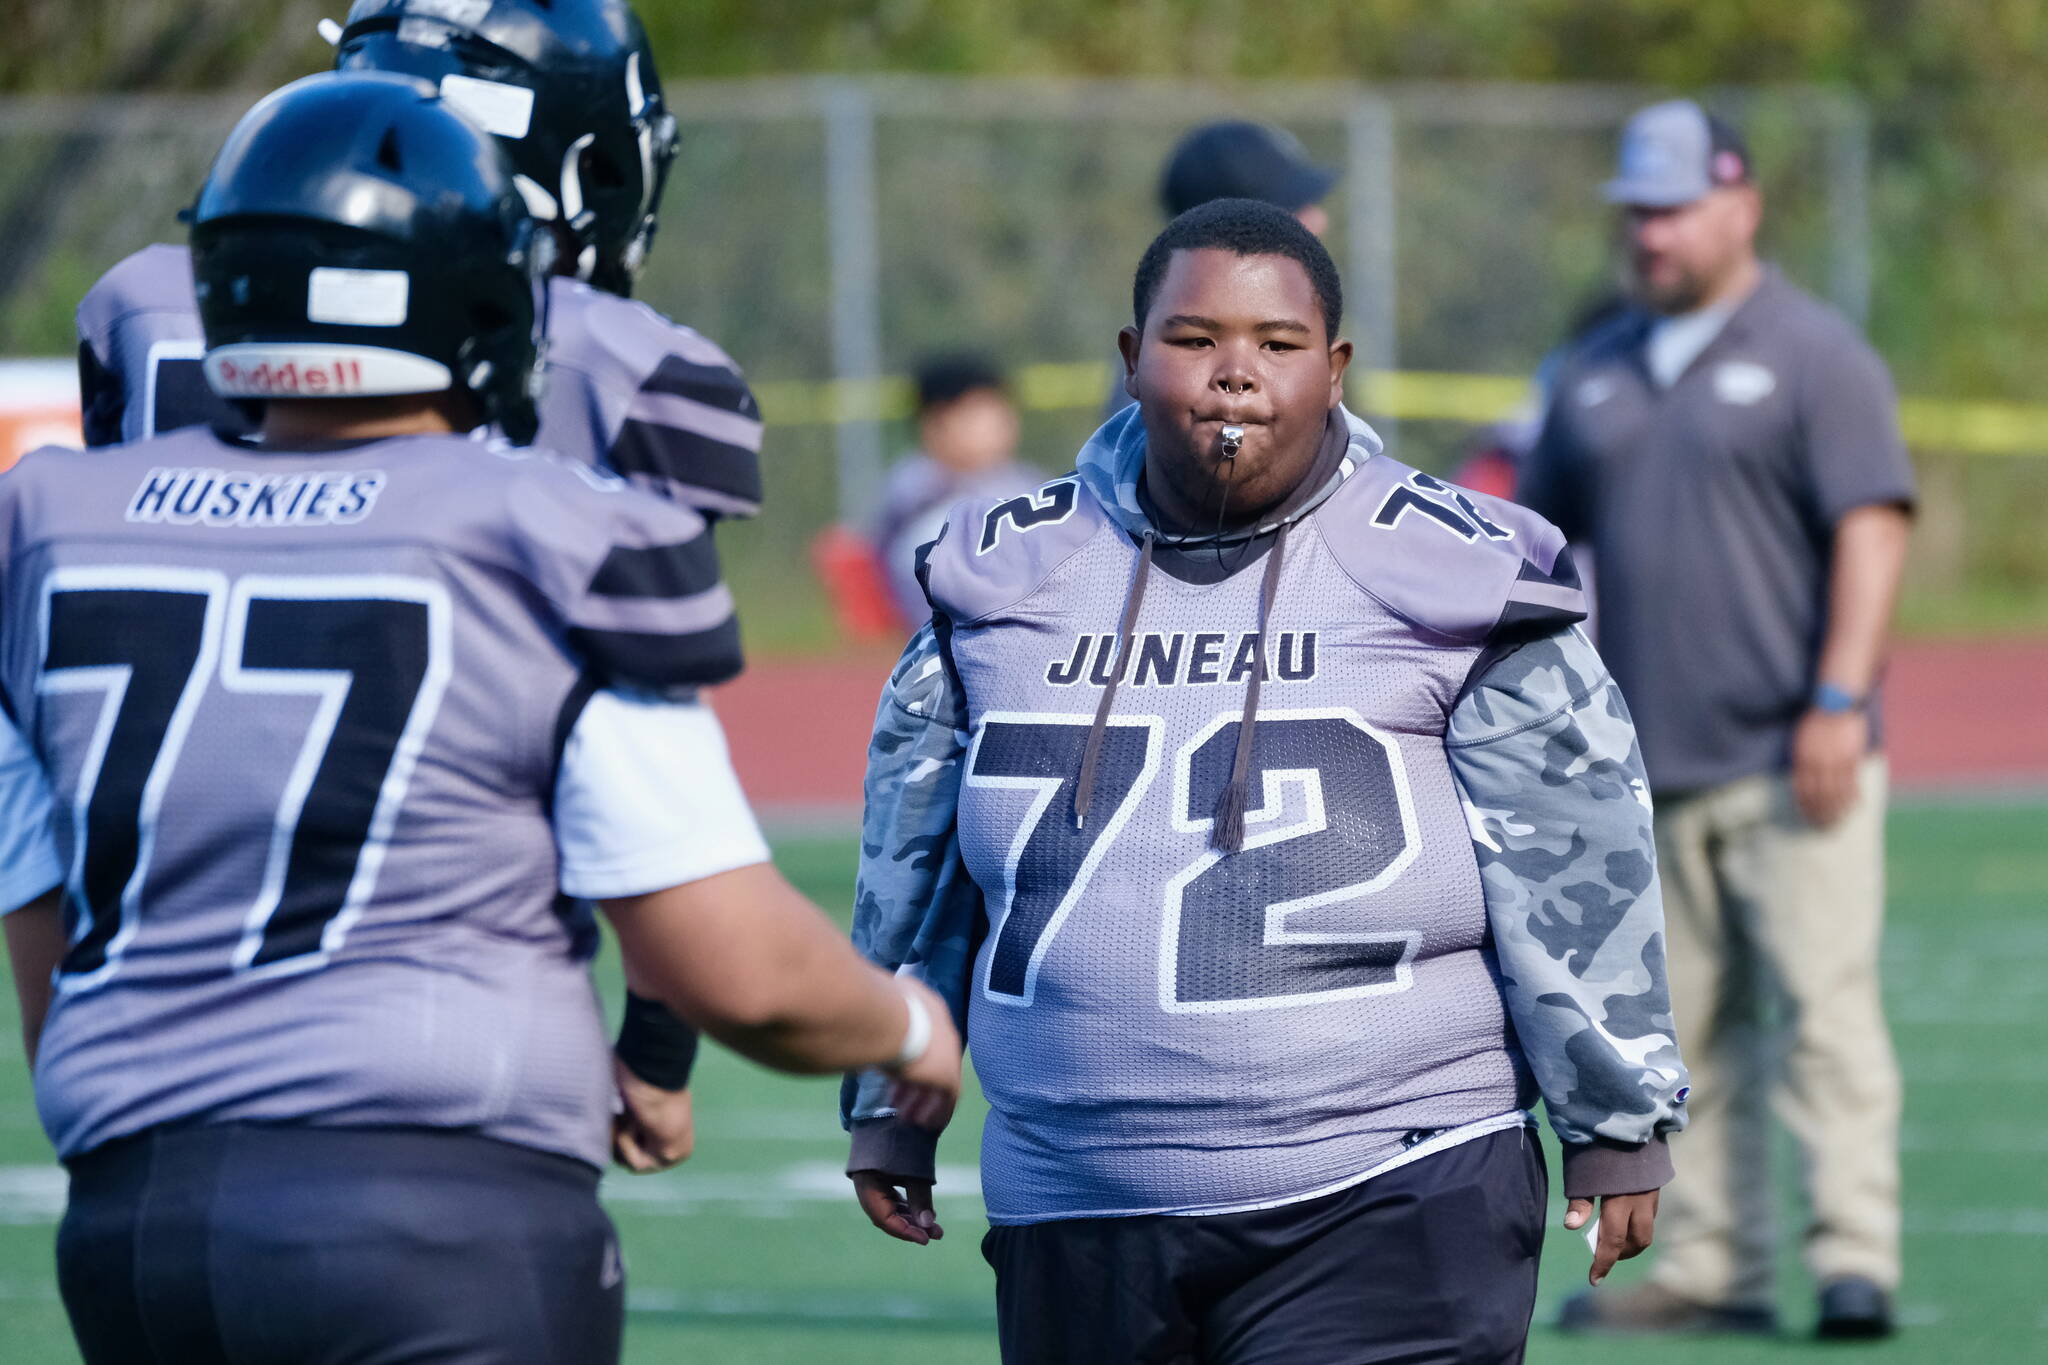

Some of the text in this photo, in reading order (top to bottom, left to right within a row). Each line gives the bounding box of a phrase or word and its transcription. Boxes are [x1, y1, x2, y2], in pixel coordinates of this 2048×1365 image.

[125, 467, 387, 527] HUSKIES
[1369, 470, 1516, 545] 72
[1046, 631, 1319, 688] JUNEAU
[36, 565, 453, 996] 77
[966, 707, 1423, 1014] 72
